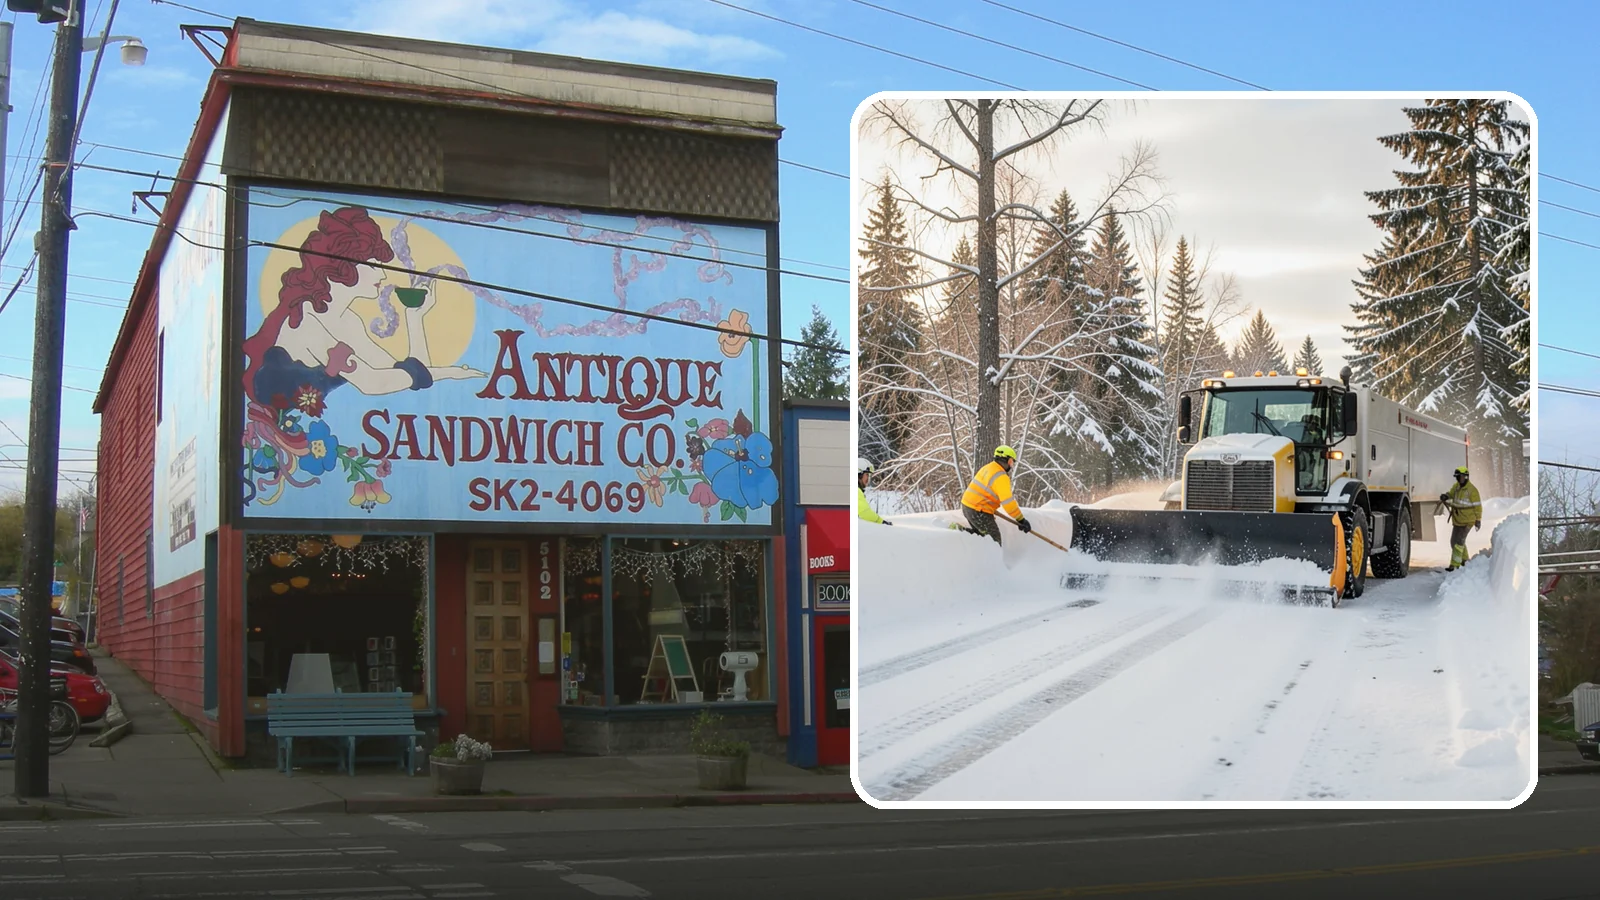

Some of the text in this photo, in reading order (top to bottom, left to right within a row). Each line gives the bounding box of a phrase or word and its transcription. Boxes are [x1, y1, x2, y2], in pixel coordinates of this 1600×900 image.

[476, 329, 723, 420] ANTIQUE
[362, 409, 685, 468] SANDWICH CO.
[469, 477, 646, 513] SK2-4069
[540, 542, 552, 599] 5102
[809, 555, 834, 569] BOOKS
